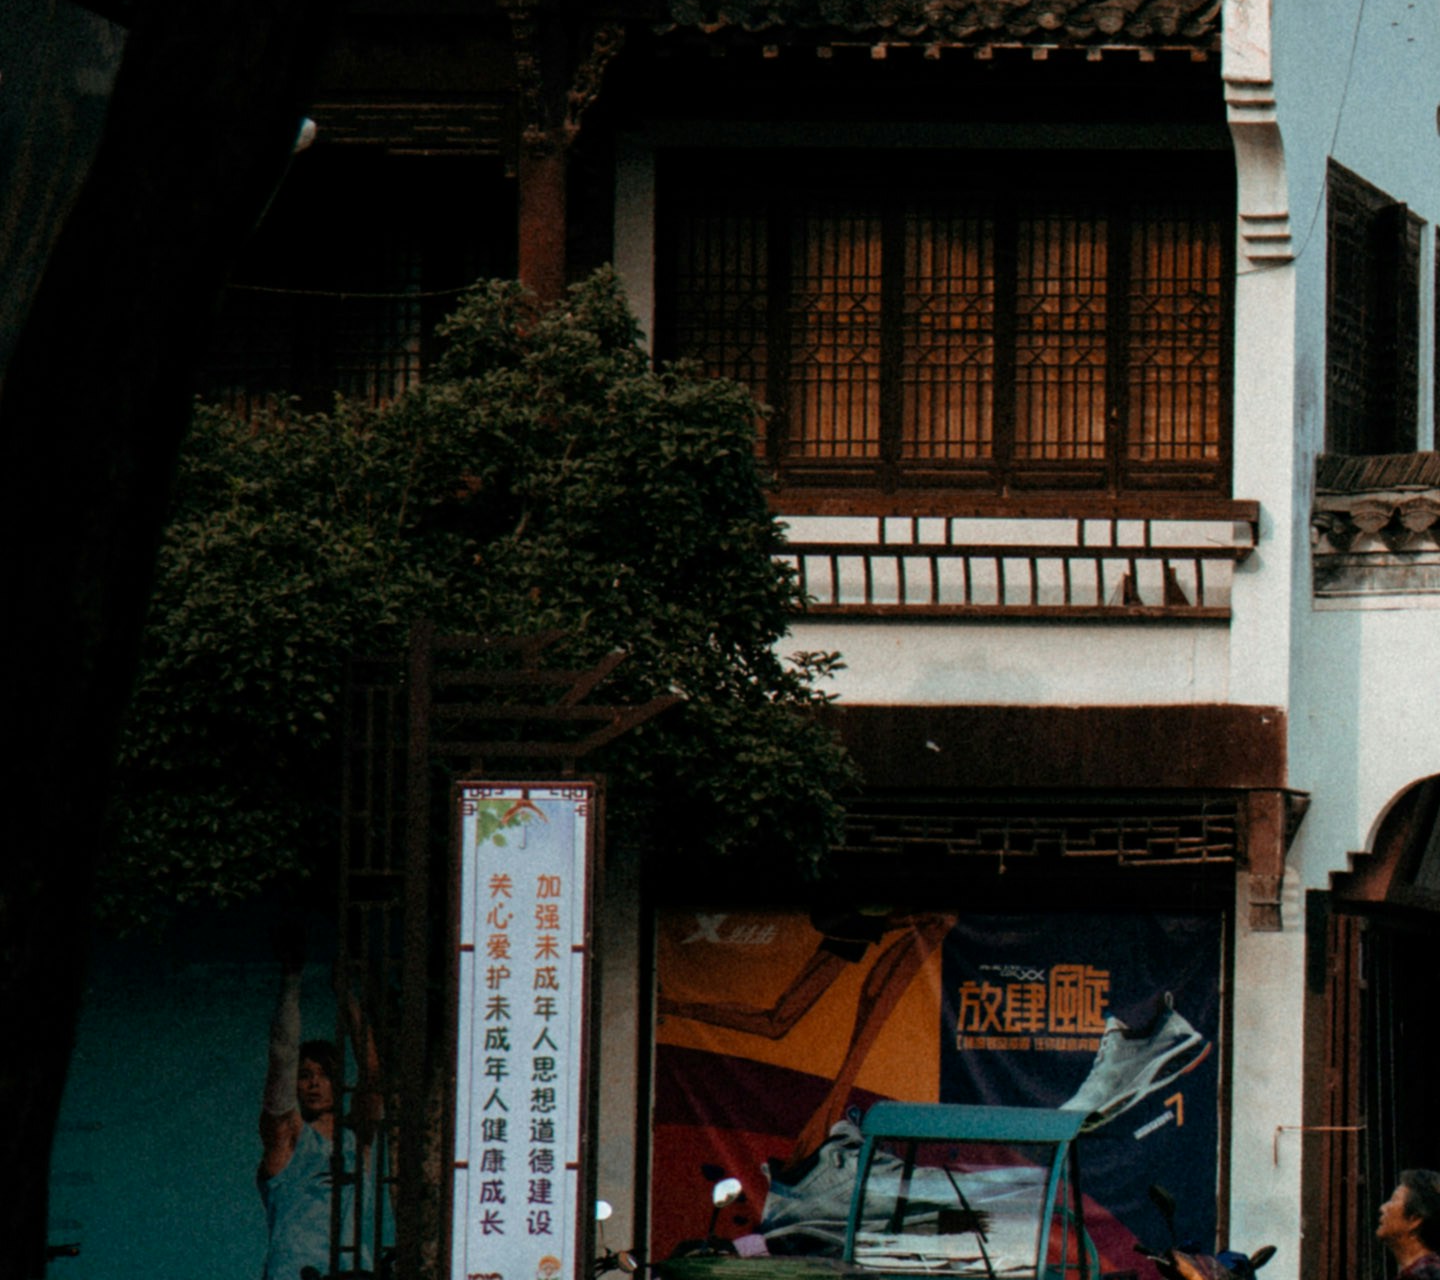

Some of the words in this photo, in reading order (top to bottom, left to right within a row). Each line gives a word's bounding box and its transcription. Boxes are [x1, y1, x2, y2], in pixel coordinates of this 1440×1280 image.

[478, 874, 514, 1237] 关心爱护未成年人健康成长
[526, 874, 562, 1237] 加强未成年人思想道德建设
